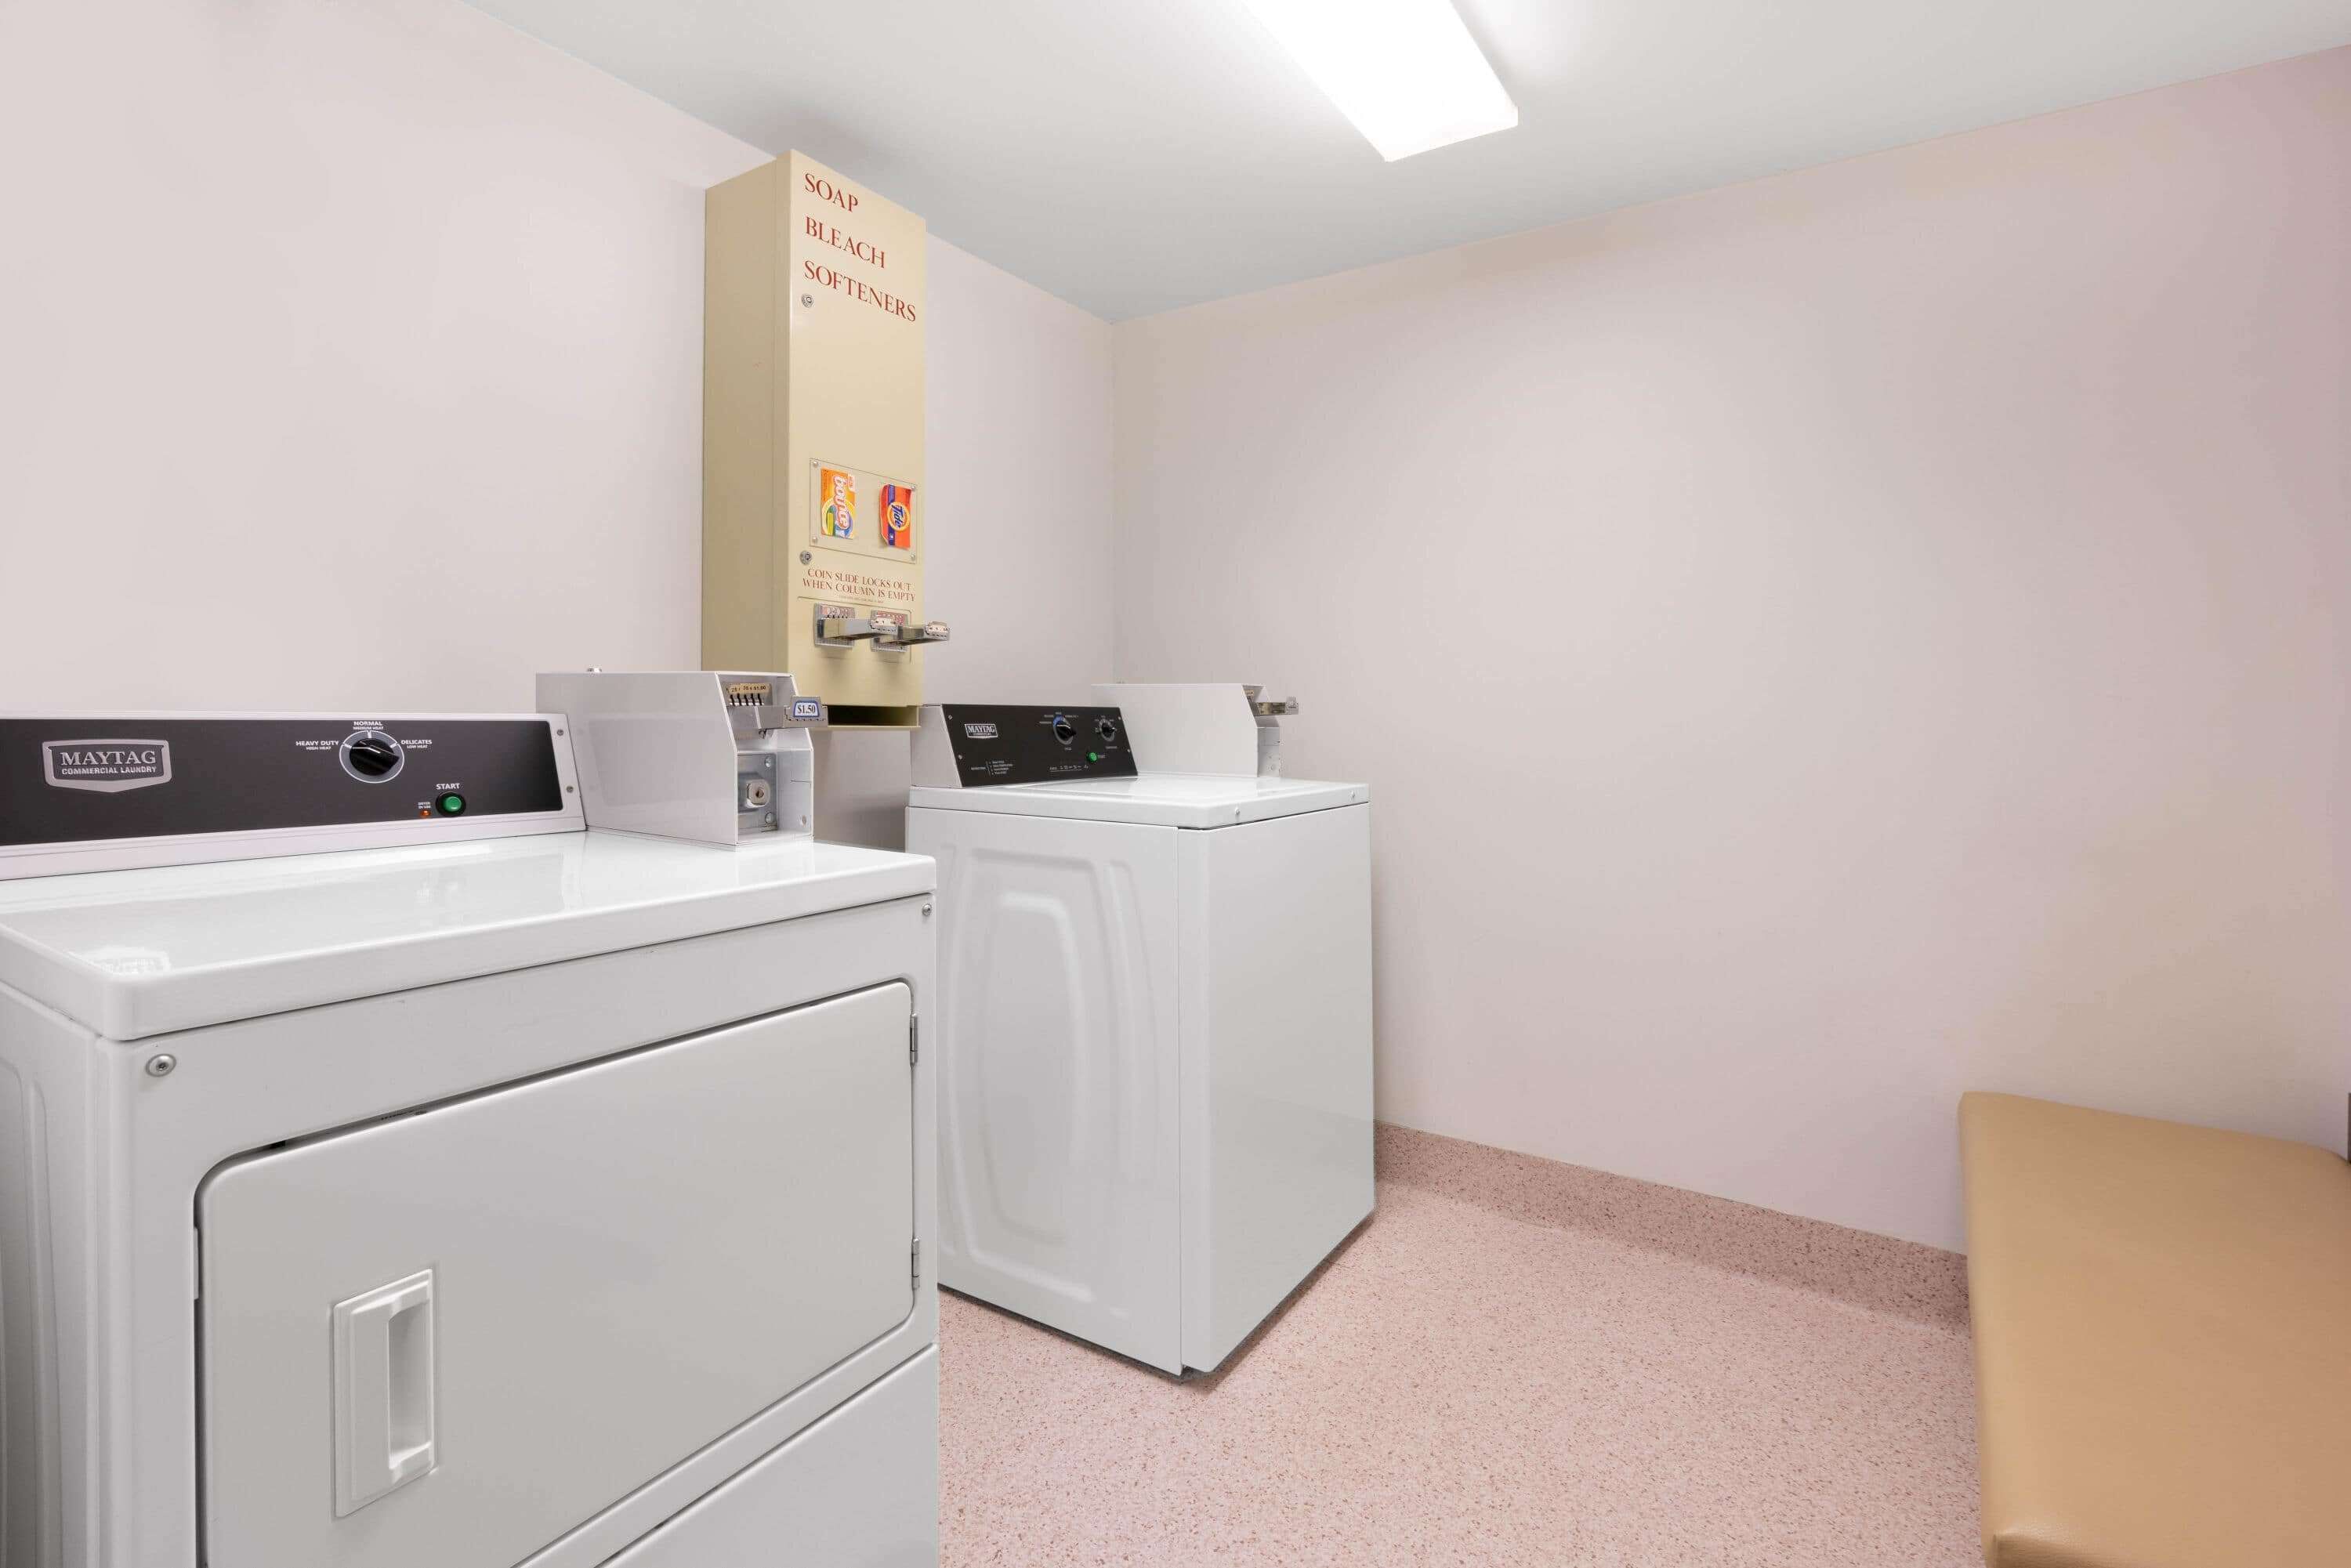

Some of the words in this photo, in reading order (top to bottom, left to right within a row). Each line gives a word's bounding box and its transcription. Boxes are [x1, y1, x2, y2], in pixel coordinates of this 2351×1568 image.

[805, 172, 859, 212] SOAP
[806, 215, 886, 268] BLEACH
[804, 260, 916, 322] SOFTENERS
[891, 504, 904, 528] Tide
[802, 578, 832, 589] WHEN
[835, 583, 875, 596] COLUMN
[877, 589, 886, 598] IS
[888, 590, 916, 602] EMPTY
[807, 568, 832, 579] COIN
[835, 572, 860, 584] SLIDE
[862, 576, 891, 588] LOCKS
[893, 581, 912, 591] OUT
[797, 704, 816, 714] $1.50
[967, 725, 995, 733] MAYTAG
[60, 751, 156, 766] MAYTAG
